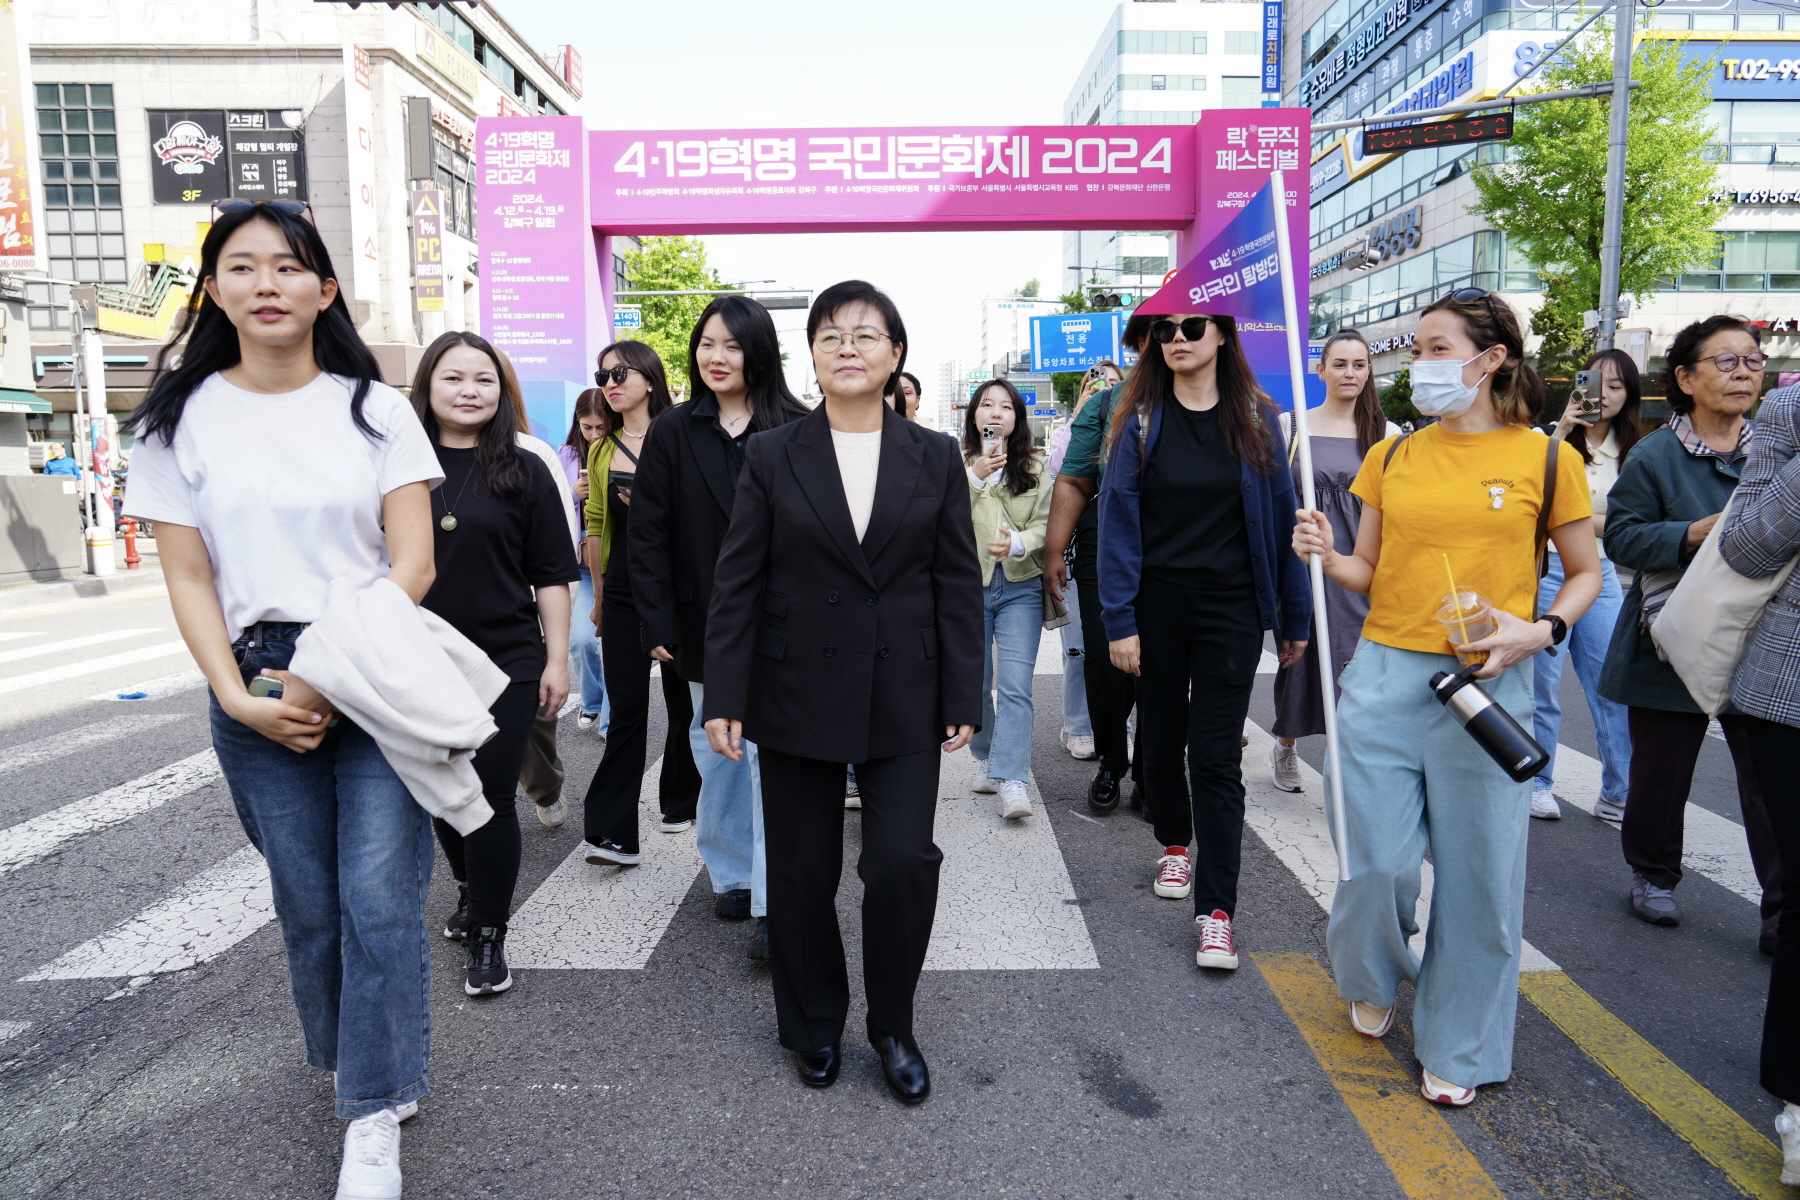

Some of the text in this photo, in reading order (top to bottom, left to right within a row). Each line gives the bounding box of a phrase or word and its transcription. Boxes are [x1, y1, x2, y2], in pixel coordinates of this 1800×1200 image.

[1266, 5, 1278, 89] 미래로치과의원
[1414, 28, 1433, 59] 통증
[229, 114, 264, 127] 스크린
[484, 131, 555, 149] 4·19혁명
[259, 142, 274, 152] 멀티
[276, 142, 298, 152] 게임장
[485, 149, 570, 168] 국민문화제
[614, 134, 1172, 182] 4·19혁명 국민문화제 2024
[1216, 149, 1299, 171] 페스티벌
[486, 169, 536, 184] 2024
[798, 186, 817, 194] 강북구
[825, 186, 838, 194] 주관
[928, 184, 1079, 193] 후원 국가보훈부 서울특별시 서울특별시교육청 KBS
[1086, 183, 1171, 192] 협찬 강북문화재단 신한은행
[182, 190, 202, 202] 3F
[512, 194, 545, 204] 2024.
[1216, 199, 1246, 208] 강북구청
[419, 218, 436, 236] 1%
[503, 217, 555, 228] 강북구 일원
[417, 237, 441, 263] PC
[417, 264, 443, 277] ARENA
[418, 279, 442, 288] PREMIUM
[1189, 252, 1279, 305] 외국인 탐방단
[1042, 357, 1076, 368] 중앙차로
[1480, 478, 1515, 489] Peanuts
